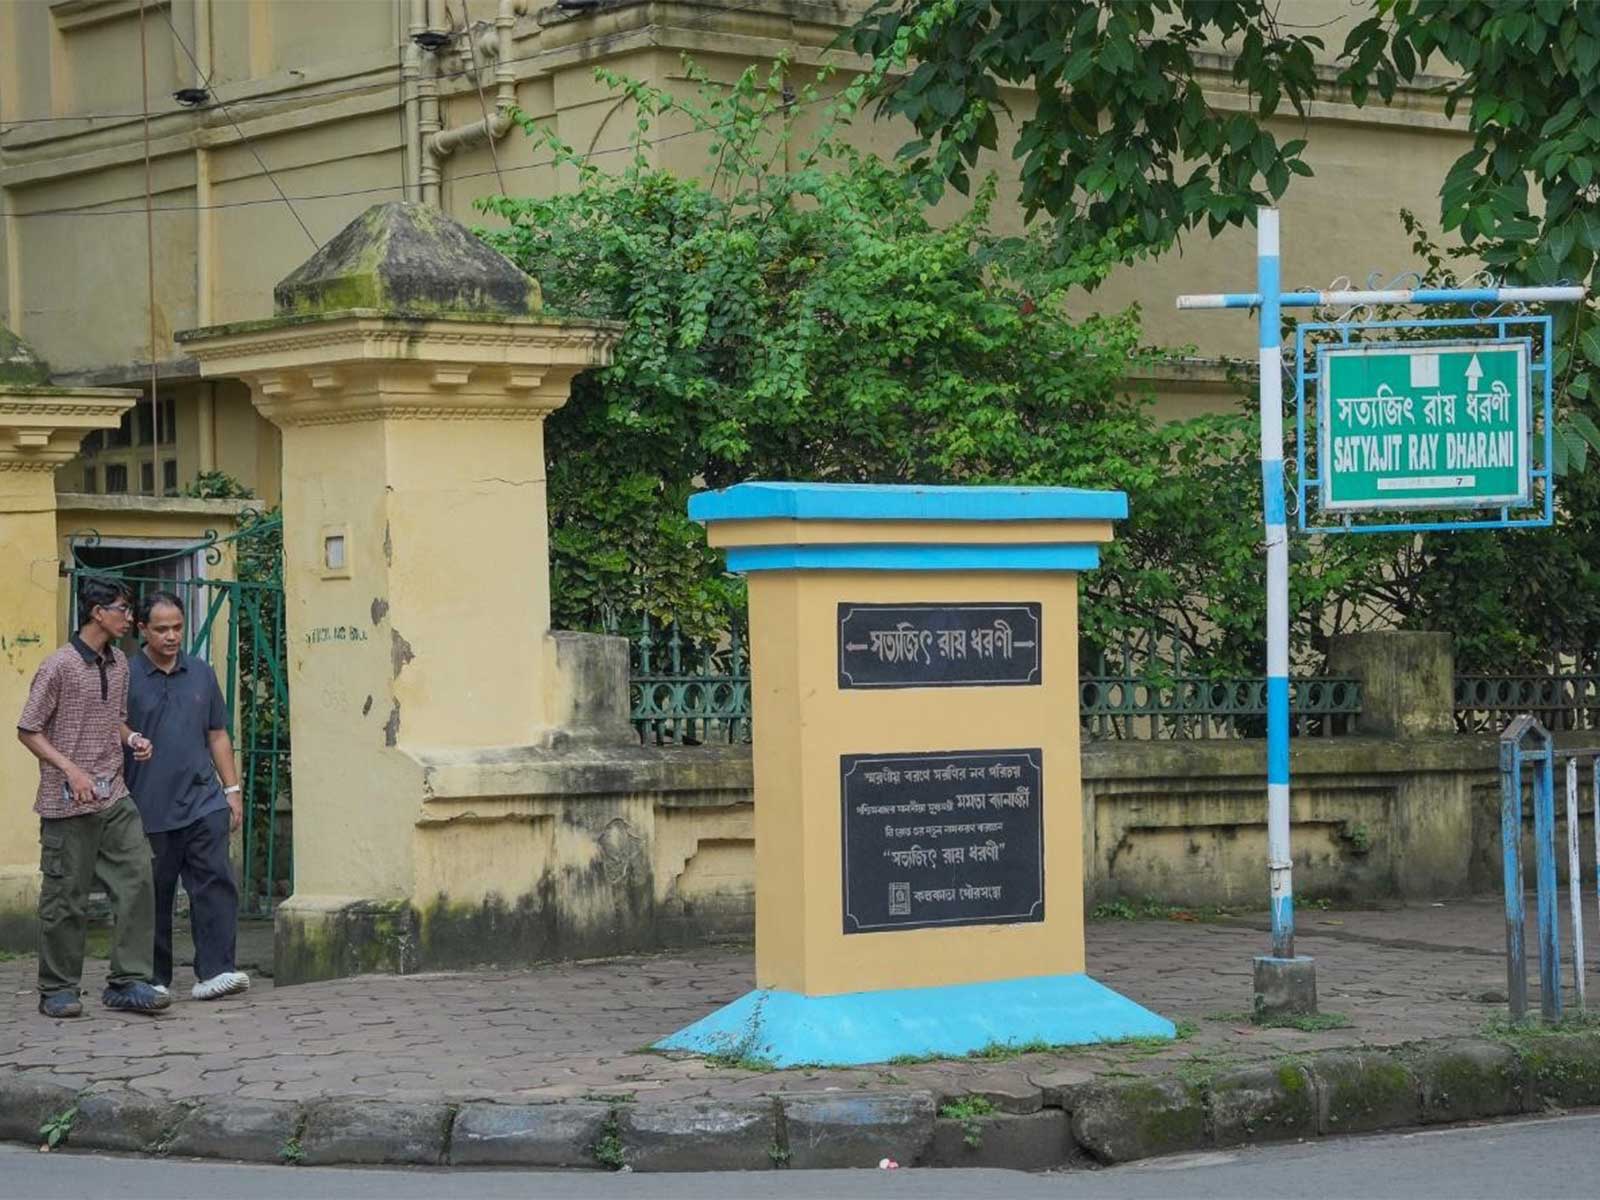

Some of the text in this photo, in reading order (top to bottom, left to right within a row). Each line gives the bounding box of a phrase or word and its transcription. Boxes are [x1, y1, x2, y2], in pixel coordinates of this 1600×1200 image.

[1336, 380, 1512, 428] সত্যজিৎ রায় ধরণী
[1334, 431, 1514, 473] SATYAJIT RAY DHARANI
[870, 619, 1013, 665] সত্যজিৎ রায় ধরণী
[956, 793, 986, 809] মমতা
[942, 849, 964, 865] রায়
